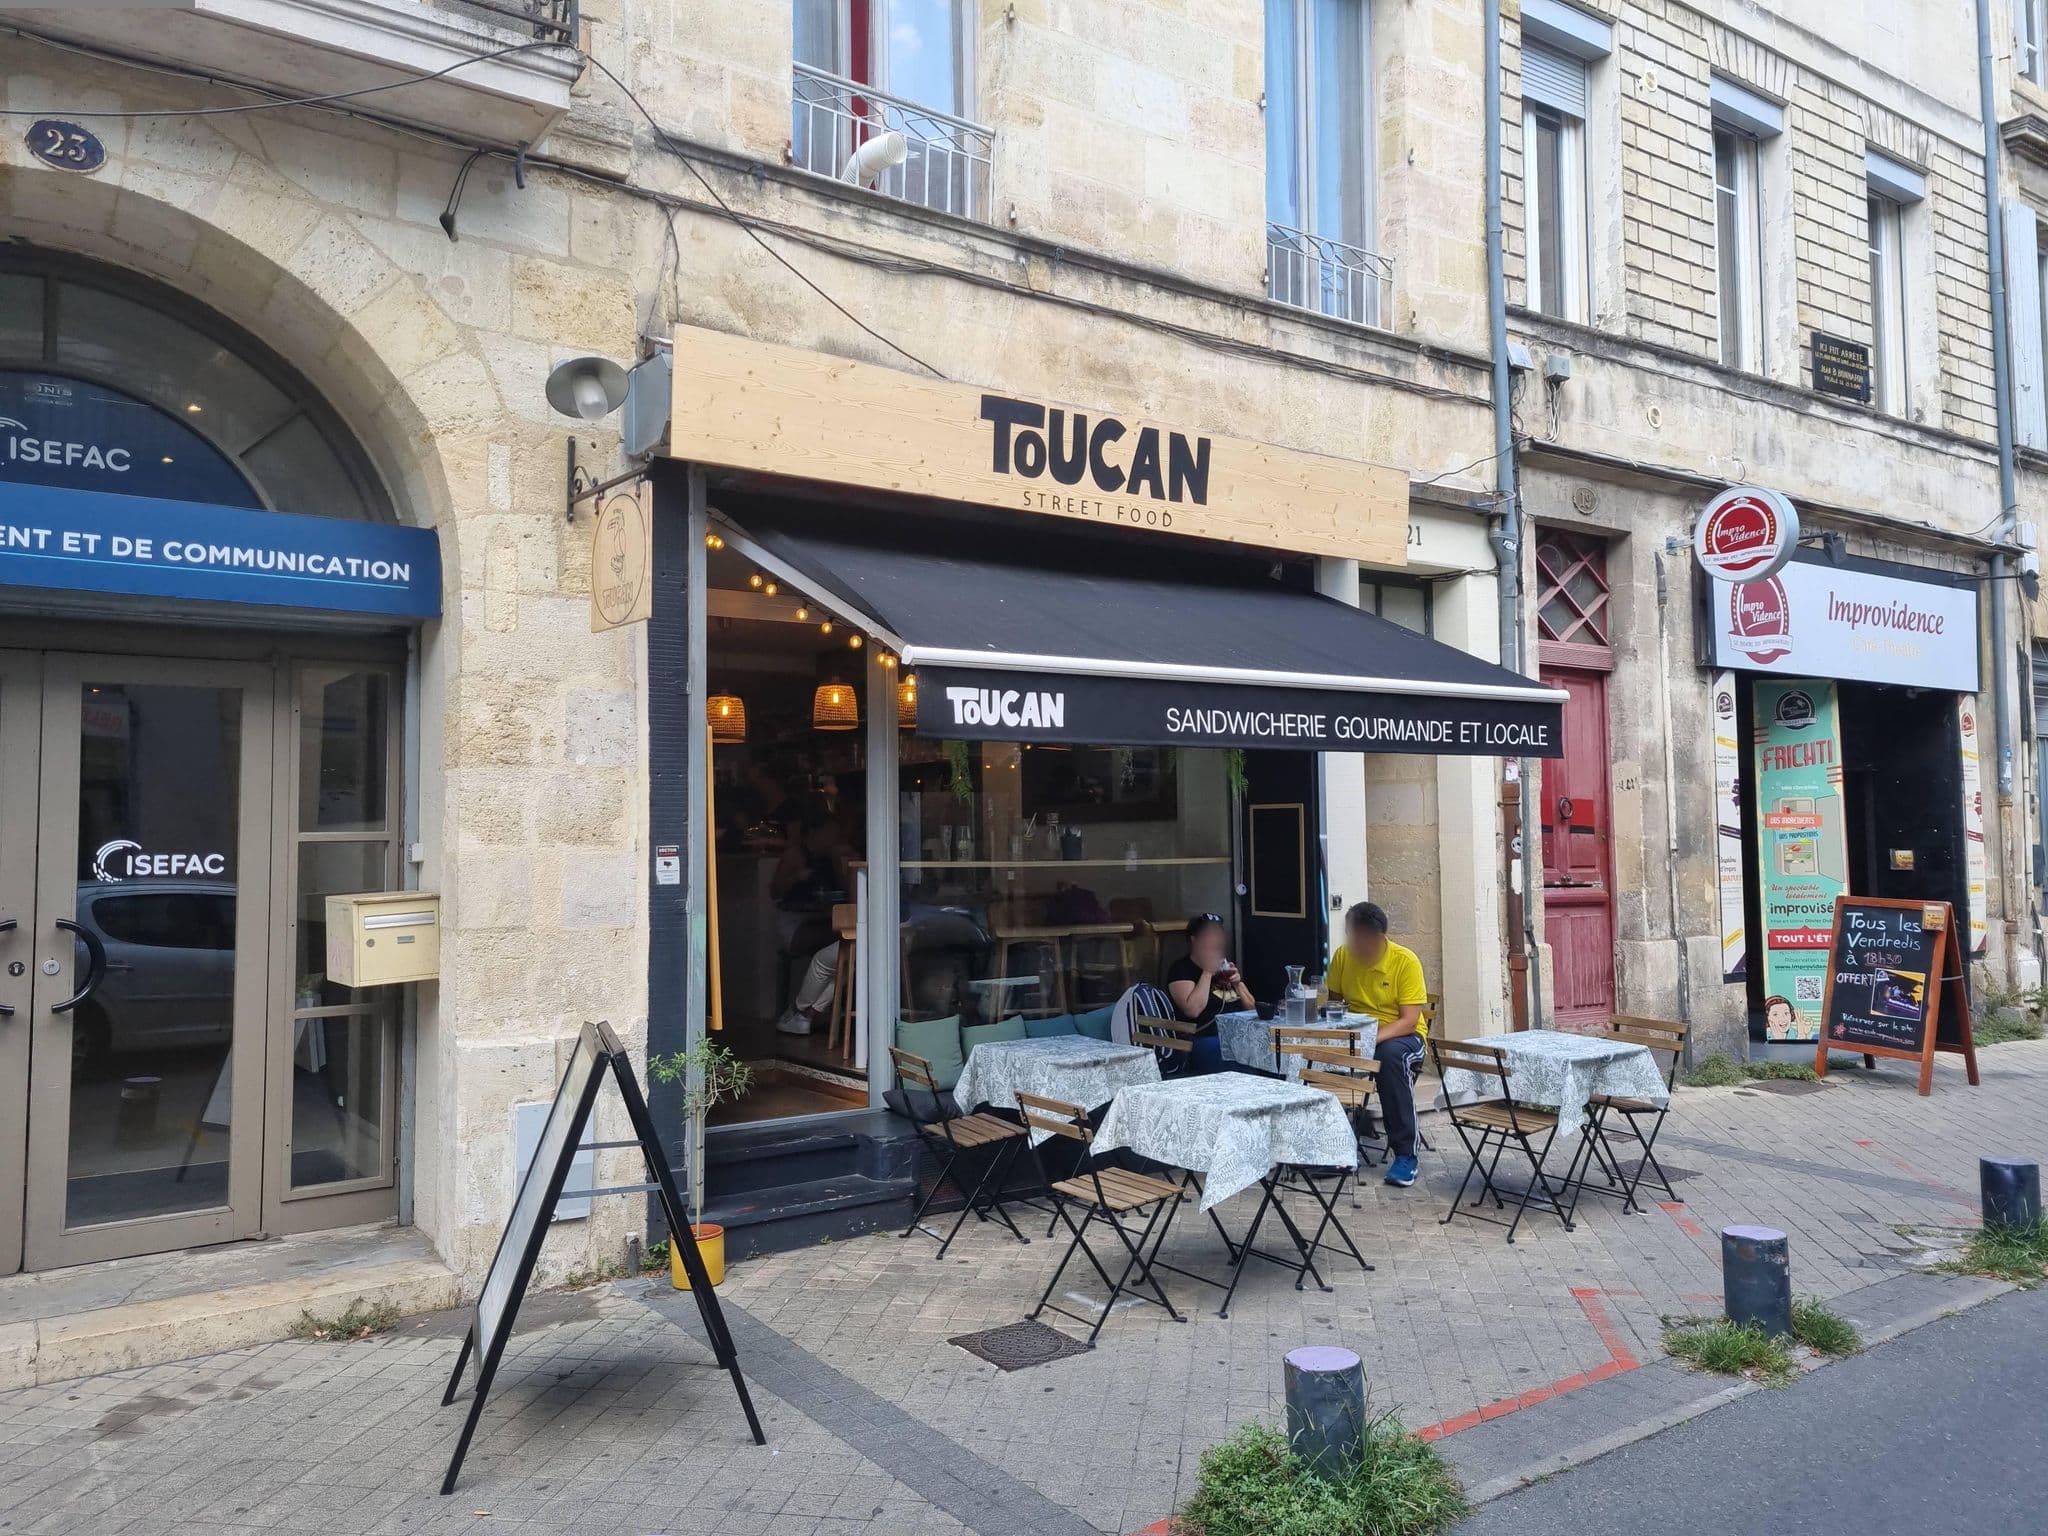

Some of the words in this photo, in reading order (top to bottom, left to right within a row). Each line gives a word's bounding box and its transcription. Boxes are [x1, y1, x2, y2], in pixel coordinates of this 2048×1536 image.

[44, 129, 87, 161] 23
[9, 436, 131, 472] ISEFAC
[1023, 491, 1103, 517] STREET
[1117, 505, 1173, 528] FOOD
[1717, 523, 1745, 539] Impro
[1730, 527, 1766, 543] Vidence
[63, 531, 101, 554] ET
[111, 536, 153, 559] DE
[163, 541, 410, 582] COMMUNICATION
[1740, 593, 1764, 615] Impro
[1828, 591, 1944, 635] Improvidence
[1752, 609, 1781, 623] Vidence
[1166, 708, 1327, 739] SANDWICHERIE
[1334, 716, 1453, 743] GOURMANDE
[1460, 722, 1481, 744] ET
[1485, 722, 1548, 746] LOCALE
[1762, 740, 1833, 771] FRICHTI
[126, 853, 225, 876] ISEFAC
[1770, 902, 1834, 916] improvisé
[1846, 912, 1886, 930] Tous
[1899, 913, 1922, 933] les
[1776, 934, 1806, 943] TOUT
[1807, 932, 1832, 943] L'ÉT
[1847, 932, 1921, 950] Vendredis
[1846, 950, 1859, 966] à
[1863, 952, 1902, 966] 18h30
[1836, 972, 1874, 986] OFFERT
